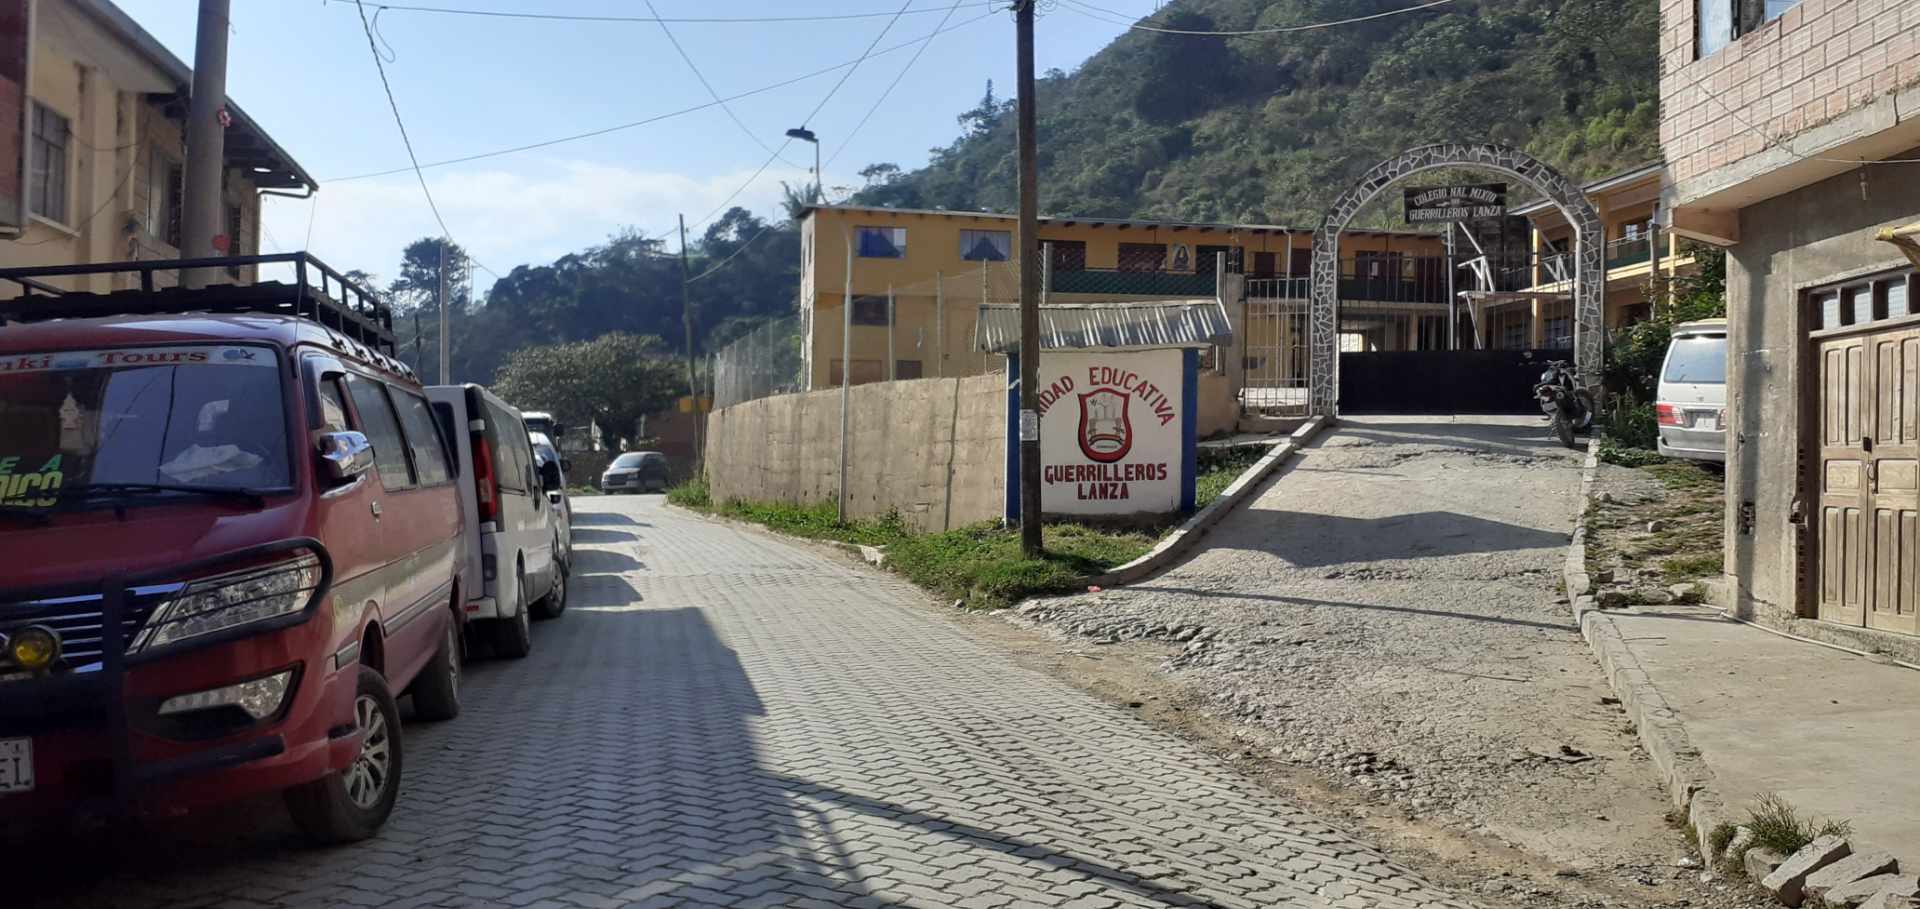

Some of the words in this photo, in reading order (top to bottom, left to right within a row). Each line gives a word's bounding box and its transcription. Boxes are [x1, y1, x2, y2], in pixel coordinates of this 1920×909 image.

[1414, 188, 1447, 206] COLEGIO
[1470, 187, 1497, 203] MIXTO
[1409, 207, 1468, 220] GUERRILLEROS
[1473, 205, 1501, 217] LANZA
[100, 351, 209, 364] Tours
[1088, 366, 1175, 427] EDUCATIVA
[1044, 463, 1168, 485] GUERRILLEROS
[1077, 483, 1130, 500] LANZA
